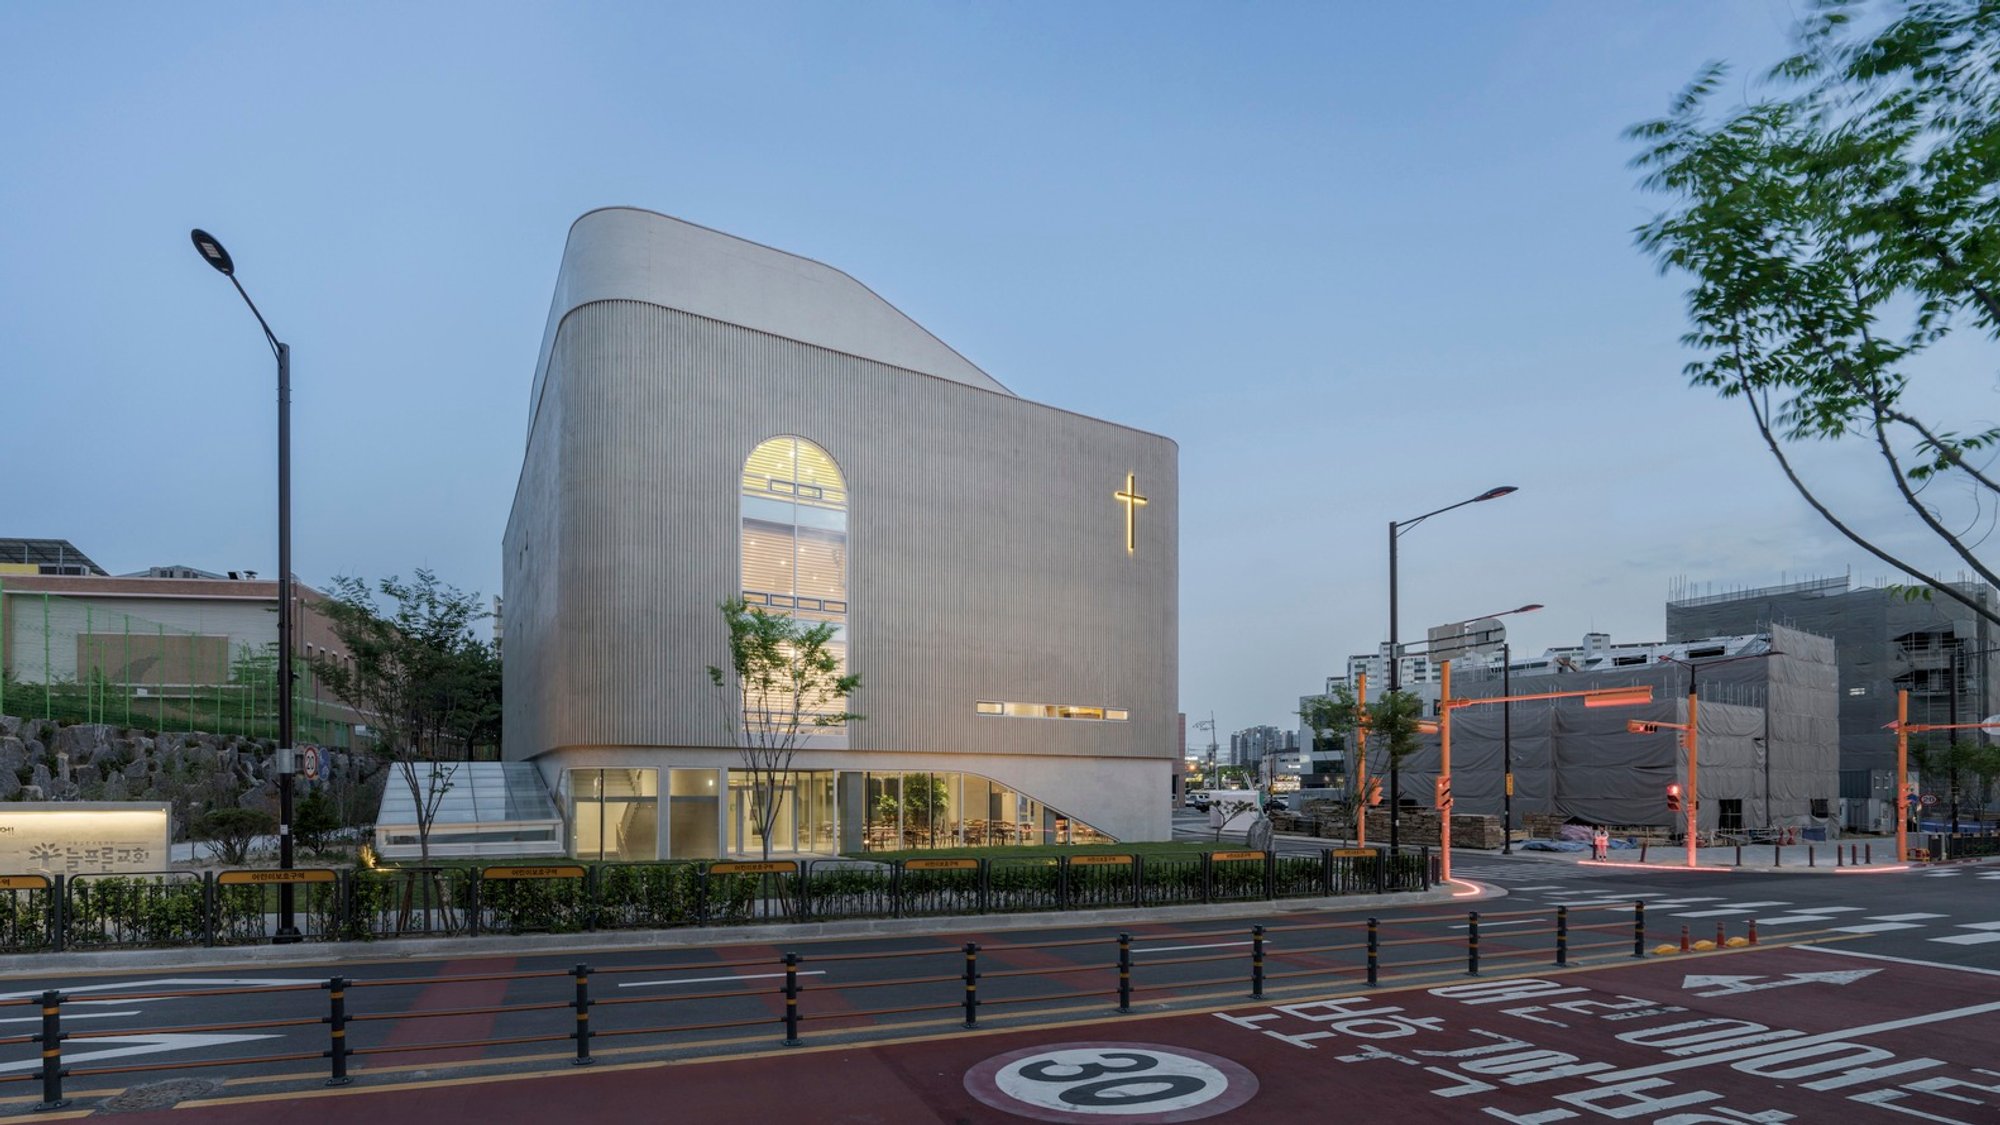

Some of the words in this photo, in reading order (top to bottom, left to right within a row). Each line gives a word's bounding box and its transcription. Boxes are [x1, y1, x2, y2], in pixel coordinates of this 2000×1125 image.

[66, 847, 149, 873] 늘푸른교회
[251, 872, 305, 880] 어린이보호구역
[1212, 997, 1617, 1098] 보호구역
[1018, 1053, 1207, 1106] 30
